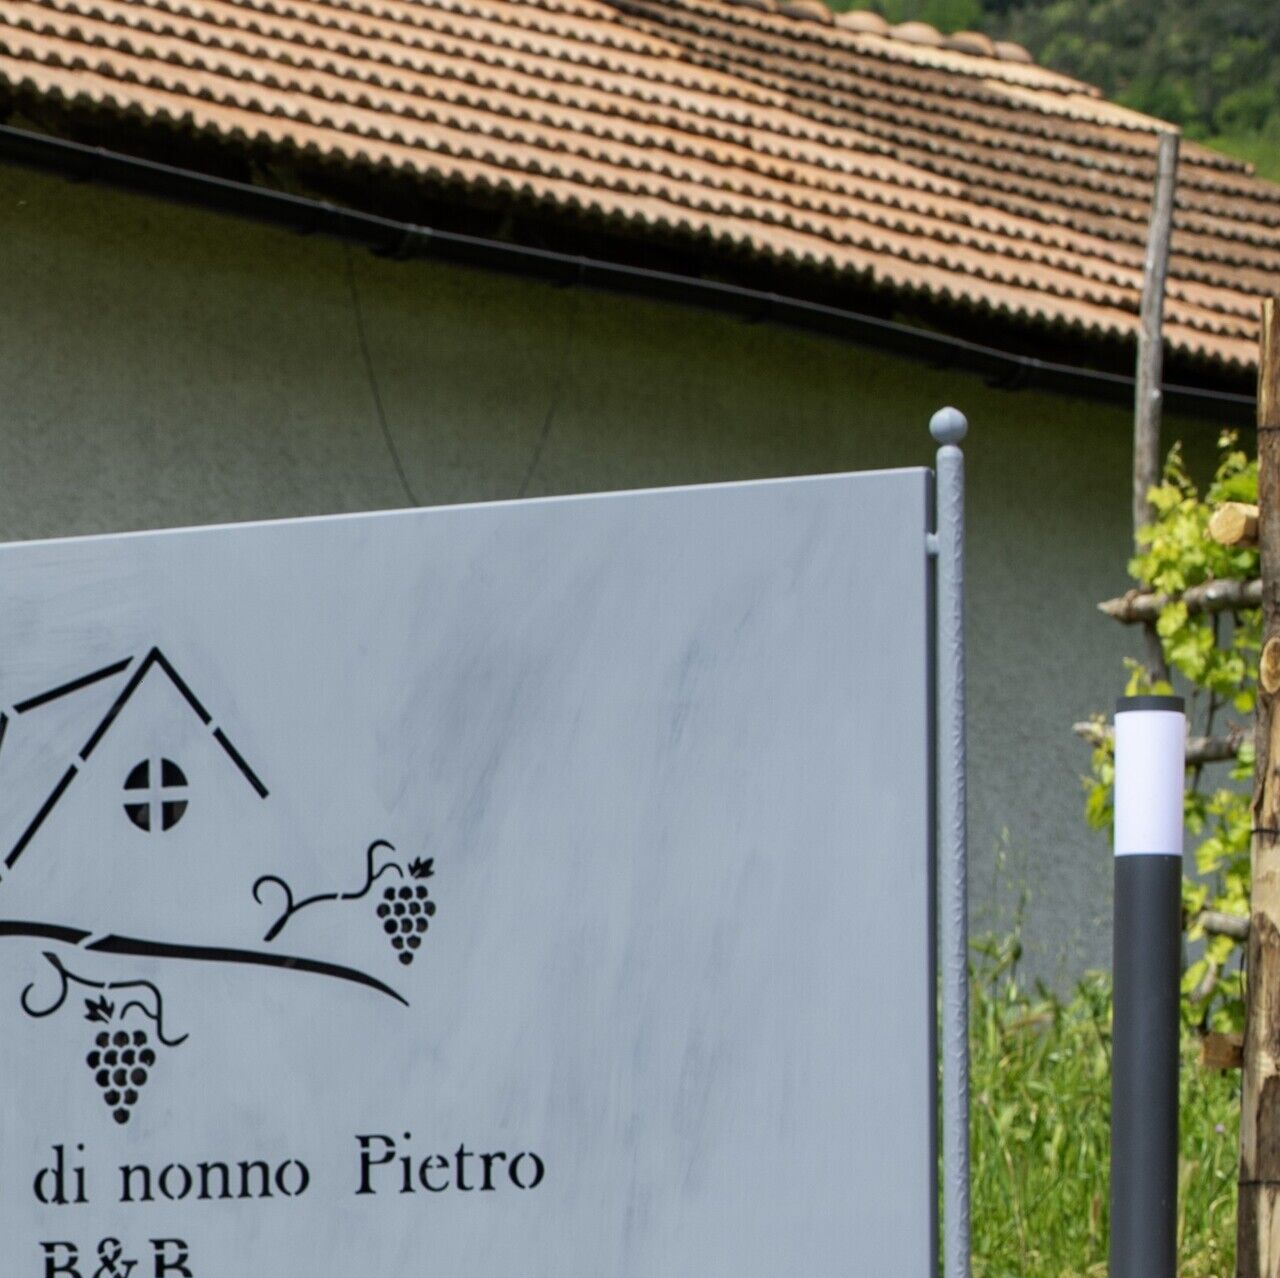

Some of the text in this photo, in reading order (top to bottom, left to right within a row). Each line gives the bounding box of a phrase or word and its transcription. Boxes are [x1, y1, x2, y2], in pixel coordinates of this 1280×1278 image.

[32, 1143, 90, 1206] di
[118, 1158, 311, 1204] nonno
[354, 1130, 546, 1196] Pietro
